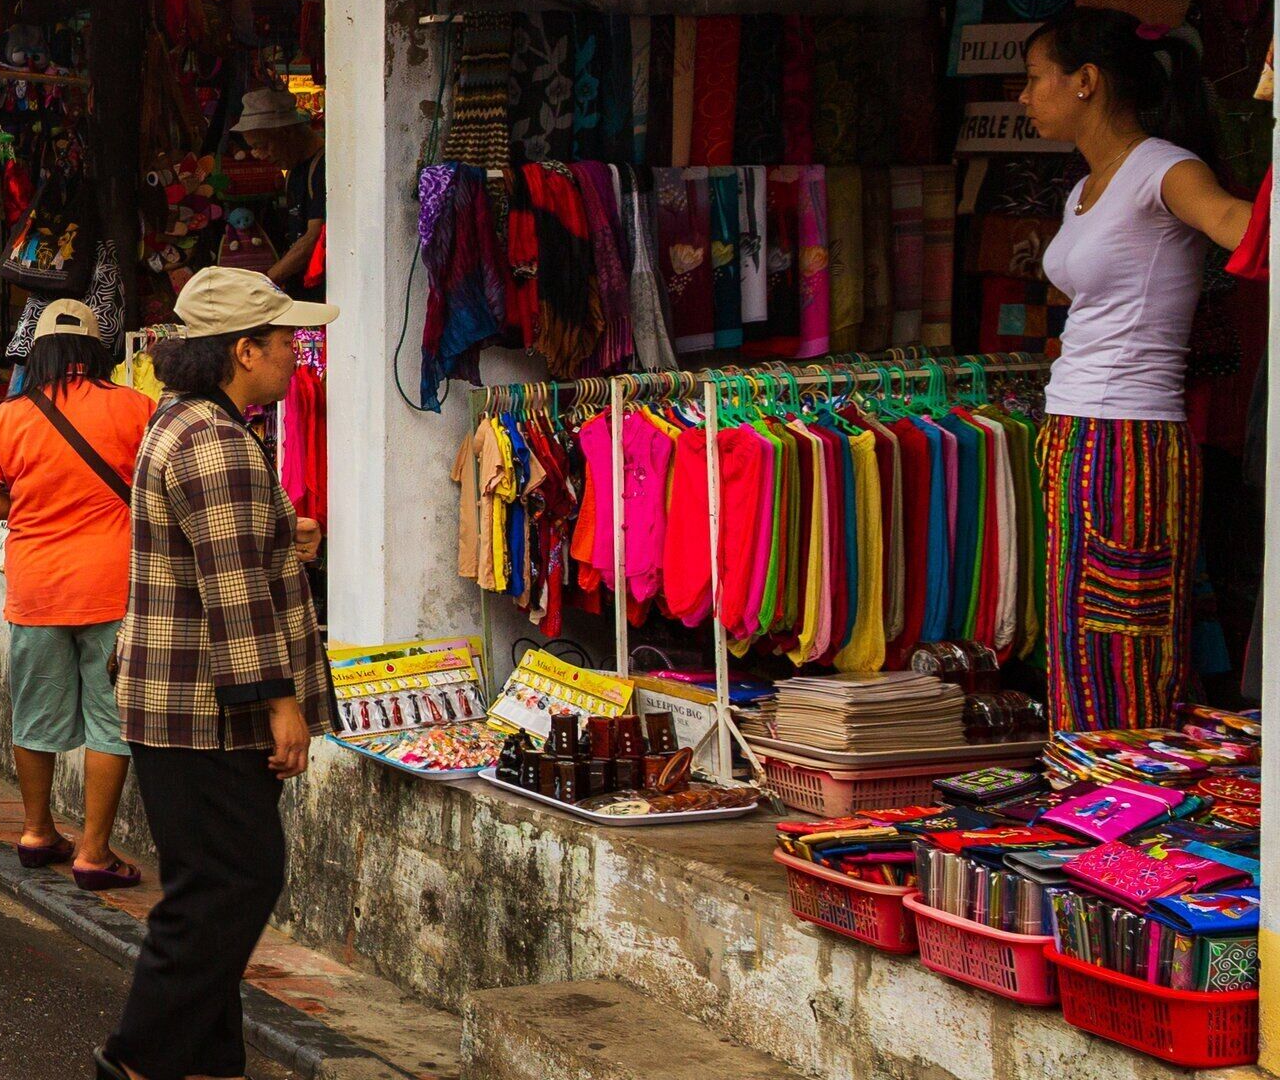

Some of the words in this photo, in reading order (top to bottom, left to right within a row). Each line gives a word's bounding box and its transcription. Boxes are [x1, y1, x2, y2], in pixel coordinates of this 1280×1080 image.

[536, 660, 551, 672] Miss
[332, 673, 355, 681] Miss
[646, 697, 685, 715] SLEEPING
[686, 707, 702, 720] BAG
